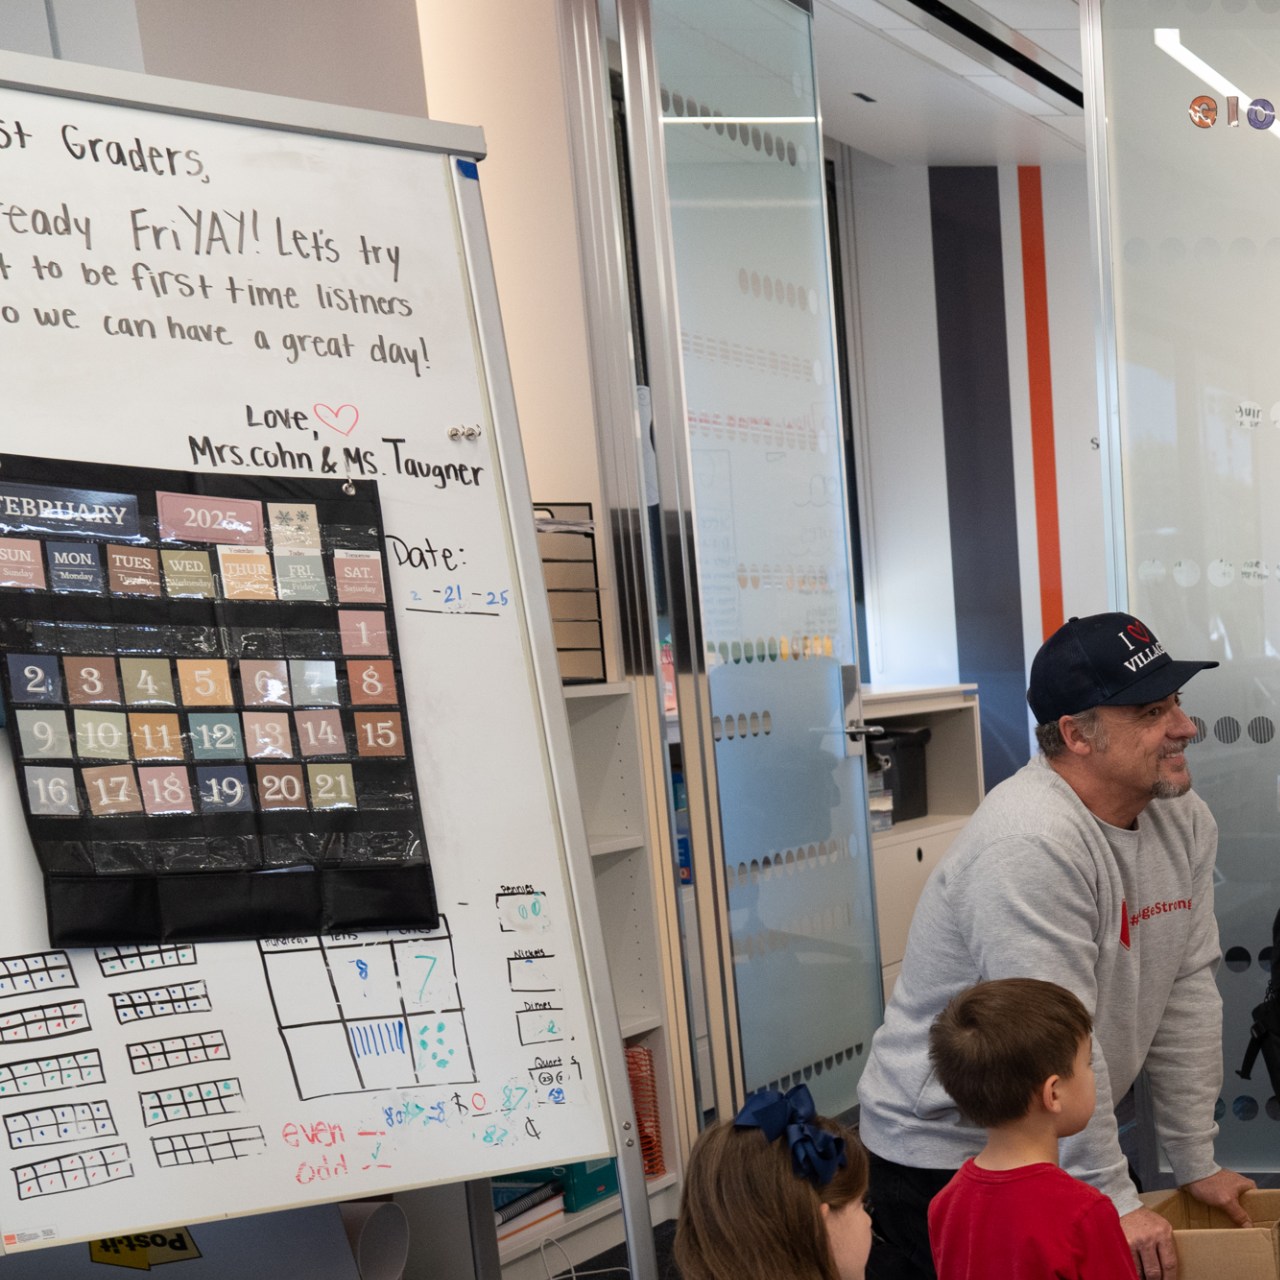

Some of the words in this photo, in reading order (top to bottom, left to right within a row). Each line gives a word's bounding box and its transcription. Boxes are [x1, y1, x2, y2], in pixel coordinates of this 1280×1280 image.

[61, 123, 210, 184] Graders,
[2, 202, 92, 250] eady
[131, 204, 260, 257] FriYAY!
[276, 217, 340, 263] Let's
[359, 235, 401, 282] try
[32, 255, 64, 281] to
[81, 262, 119, 286] be
[132, 261, 214, 299] first
[226, 275, 299, 309] time
[33, 306, 80, 329] we
[104, 314, 157, 339] can
[167, 314, 233, 346] have
[254, 330, 270, 351] a
[282, 329, 355, 377] great
[370, 336, 431, 377] day!
[246, 404, 320, 440] Love,
[382, 437, 485, 491] Taugner
[183, 506, 237, 530] 2025
[54, 551, 96, 567] MON.
[112, 555, 154, 571] TUES.
[169, 560, 207, 574] WED.
[344, 567, 374, 580] SAT.
[385, 534, 467, 571] Date:
[60, 571, 94, 584] Monday
[358, 621, 370, 646] 1
[1118, 631, 1136, 651] I
[23, 665, 48, 695] 2
[80, 667, 104, 696] 3
[136, 668, 160, 696] 4
[193, 667, 216, 696] 5
[361, 664, 384, 696] 8
[32, 720, 55, 752] 9
[81, 720, 120, 750] 10
[143, 723, 173, 751] 11
[198, 723, 235, 750] 12
[302, 720, 338, 745] 14
[362, 720, 398, 749] 15
[34, 777, 69, 805] 16
[92, 776, 129, 806] 17
[147, 772, 185, 804] 18
[206, 776, 244, 807] 19
[263, 775, 301, 801] 20
[316, 774, 349, 799] 21
[282, 1120, 347, 1148] even
